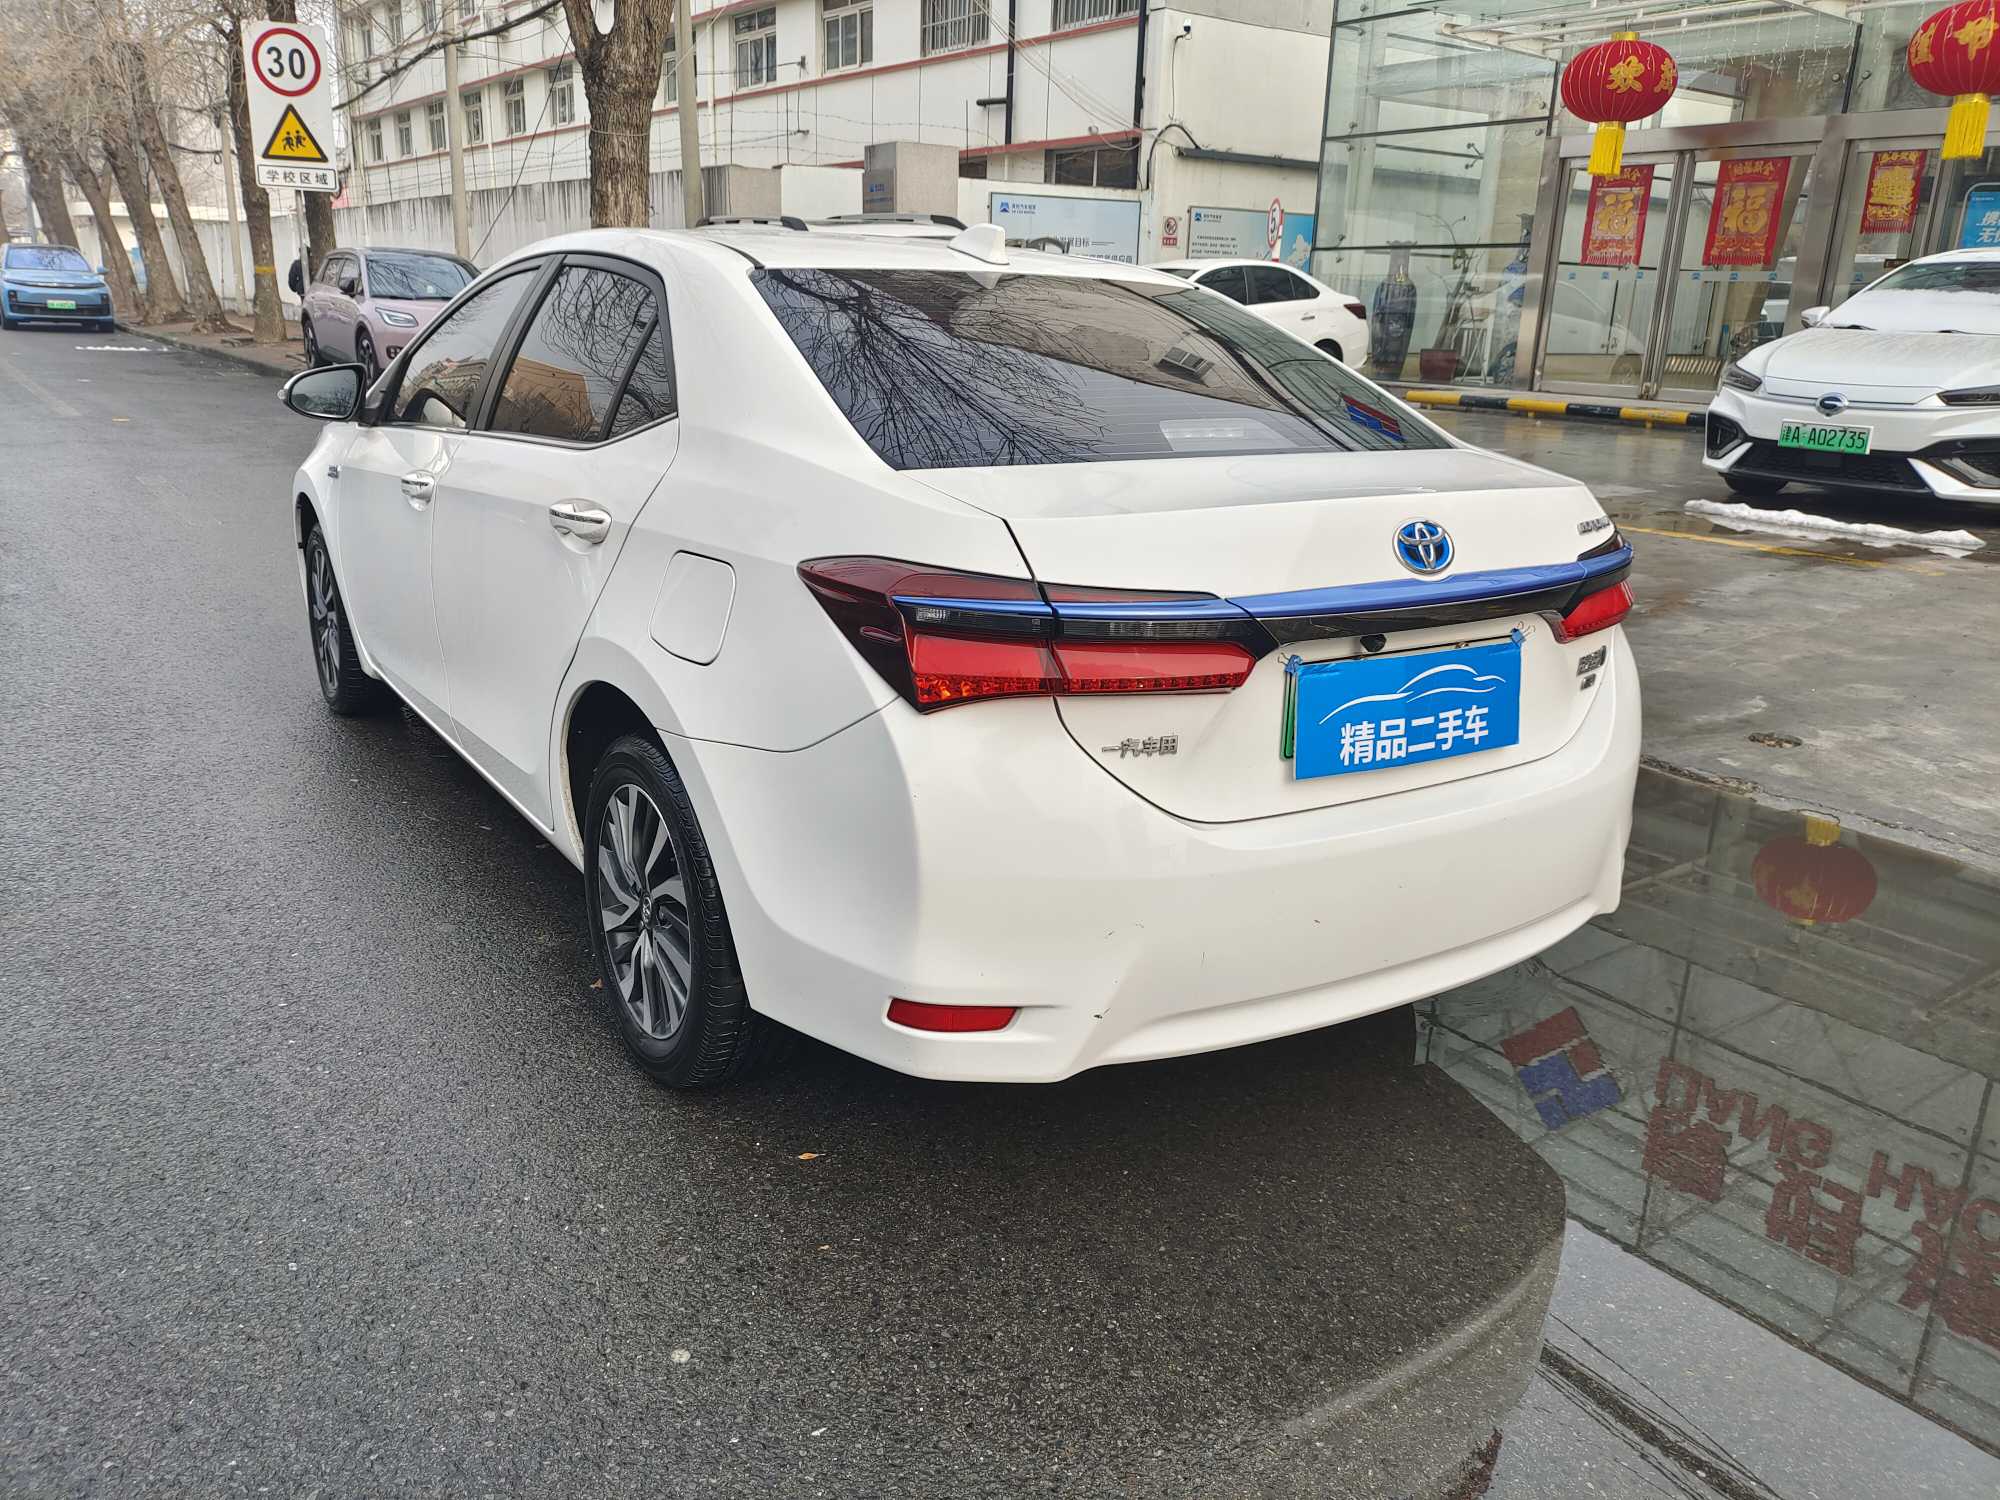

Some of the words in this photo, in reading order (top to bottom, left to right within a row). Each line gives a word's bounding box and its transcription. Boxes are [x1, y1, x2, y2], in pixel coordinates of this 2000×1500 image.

[266, 46, 306, 80] 30
[265, 169, 329, 186] 学校区域
[1339, 704, 1489, 767] 精品二手车
